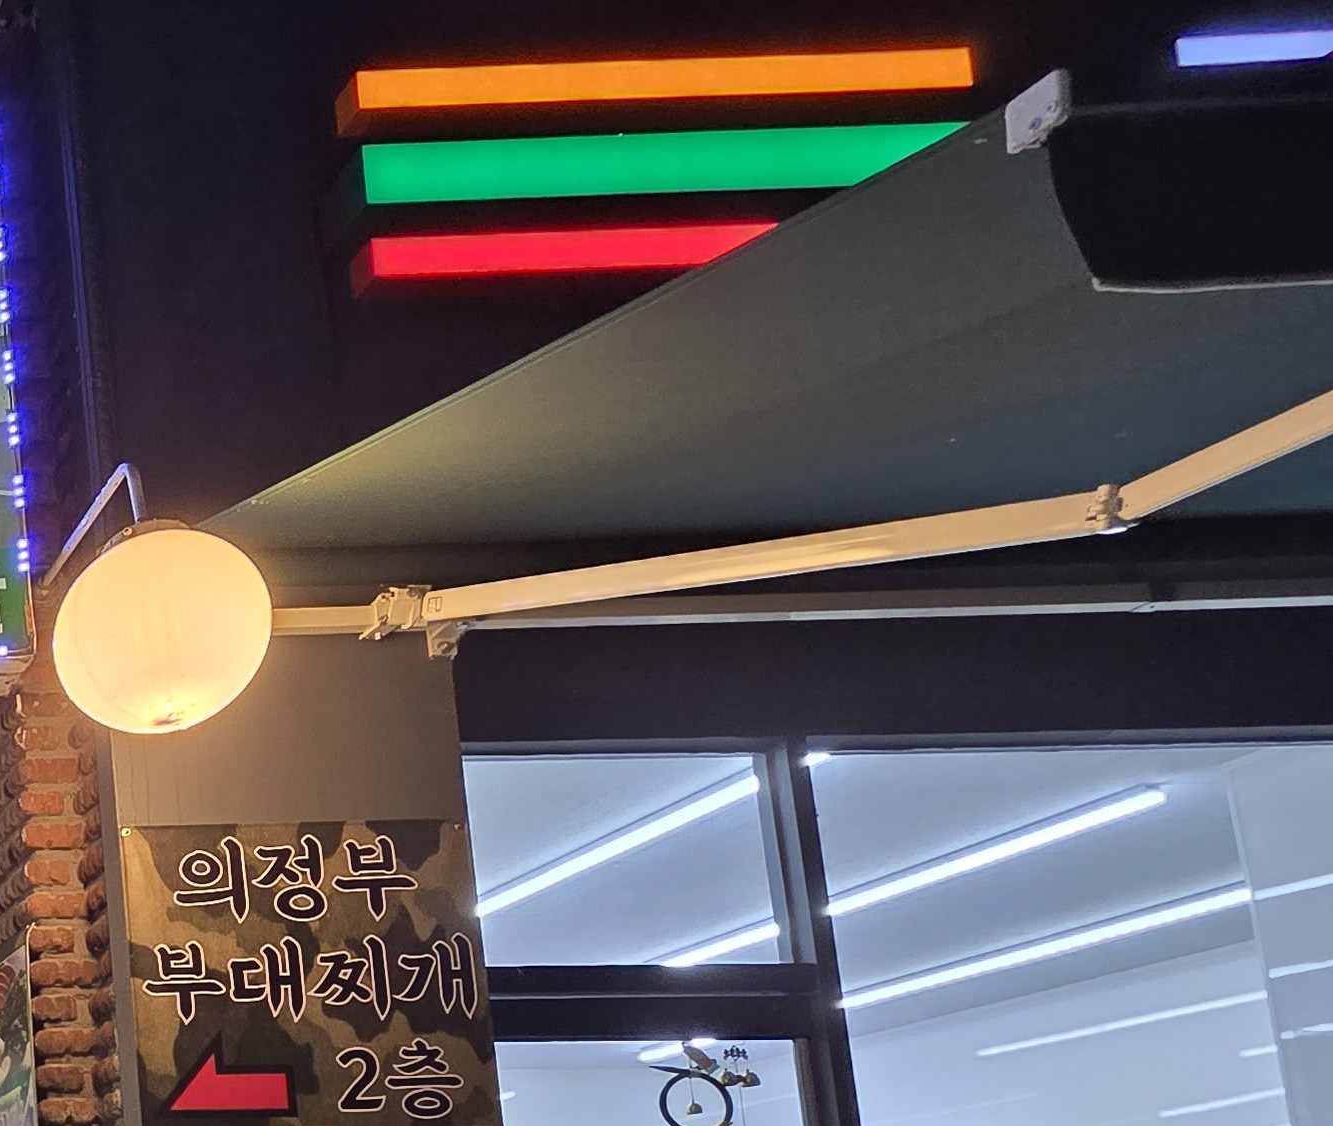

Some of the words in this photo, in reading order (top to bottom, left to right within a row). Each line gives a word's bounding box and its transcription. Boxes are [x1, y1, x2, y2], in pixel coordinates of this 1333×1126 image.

[173, 836, 418, 923] 의정부
[143, 934, 480, 1024] 부대찌개
[336, 1038, 465, 1120] 2층
